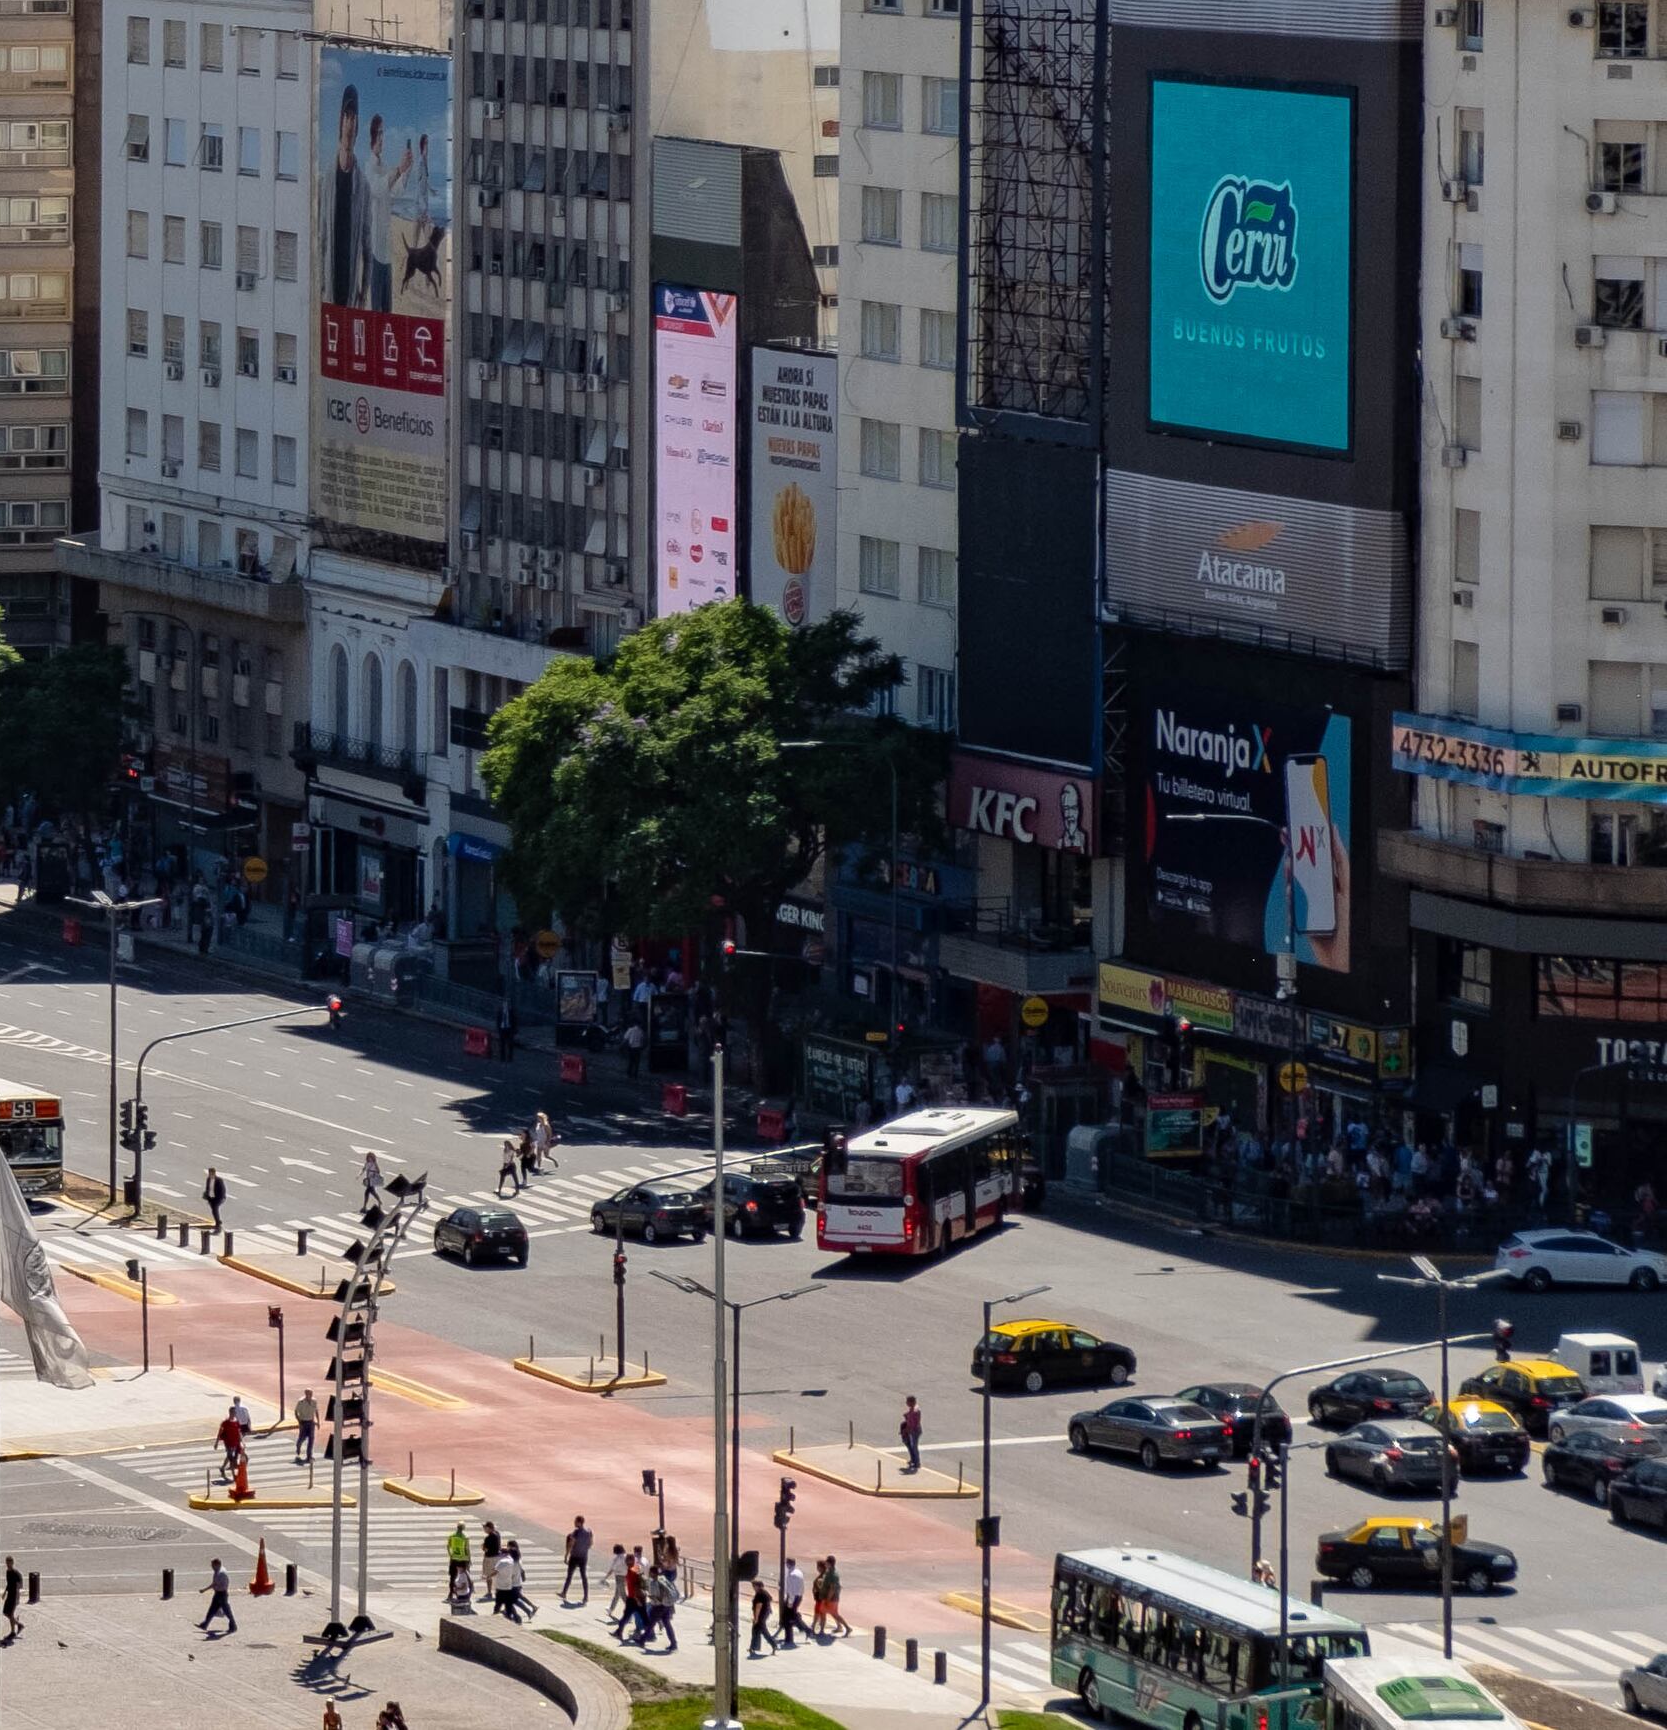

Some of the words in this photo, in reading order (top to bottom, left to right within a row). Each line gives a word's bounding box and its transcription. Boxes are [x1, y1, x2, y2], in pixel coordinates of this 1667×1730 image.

[1202, 178, 1293, 299] Cervi
[1173, 318, 1246, 350] BUENOS
[1253, 328, 1327, 360] FRUTOS
[777, 366, 804, 385] AHORA
[327, 397, 352, 423] ICBC
[374, 406, 434, 437] Beneficios
[762, 385, 801, 406] NUESTRAS
[803, 390, 829, 411] PAPAS
[782, 411, 789, 427] A
[791, 410, 801, 428] LA
[802, 413, 834, 434] ALTURA
[1196, 550, 1286, 595] Atacama
[1156, 708, 1250, 778] Naranja
[1399, 729, 1505, 778] 4732-3336
[1156, 772, 1170, 794] Tu
[1217, 787, 1253, 813] virtual.
[967, 787, 1038, 843] KFC
[1100, 974, 1148, 1002] Souvenirs
[1166, 981, 1231, 1010] MAXIKIOSCO
[14, 1101, 34, 1117] 59
